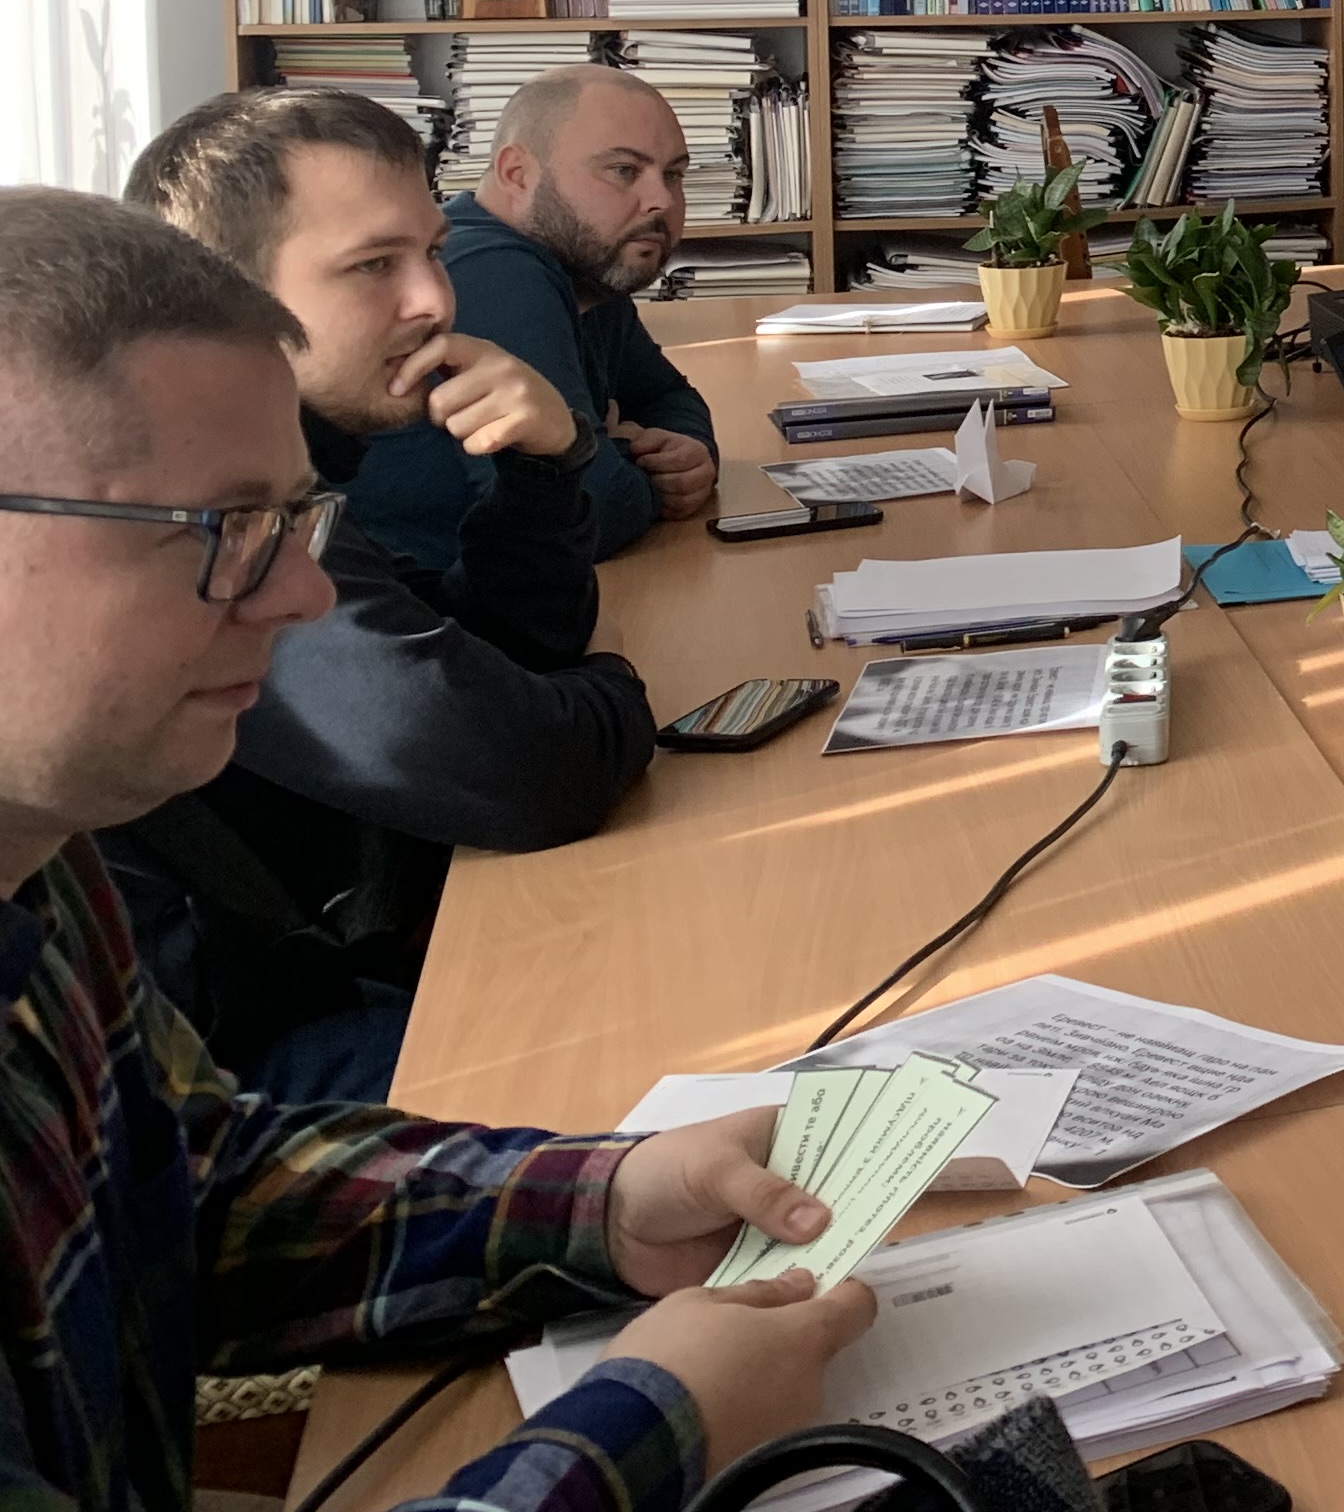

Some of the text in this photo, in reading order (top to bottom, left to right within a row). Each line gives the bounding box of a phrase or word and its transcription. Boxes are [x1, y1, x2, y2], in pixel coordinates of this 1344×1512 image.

[1014, 1042, 1033, 1050] на
[1087, 1063, 1125, 1075] 8848
[1117, 1031, 1136, 1039] не
[1230, 1062, 1249, 1070] на
[811, 1088, 825, 1112] або
[1064, 1125, 1102, 1138] 4207
